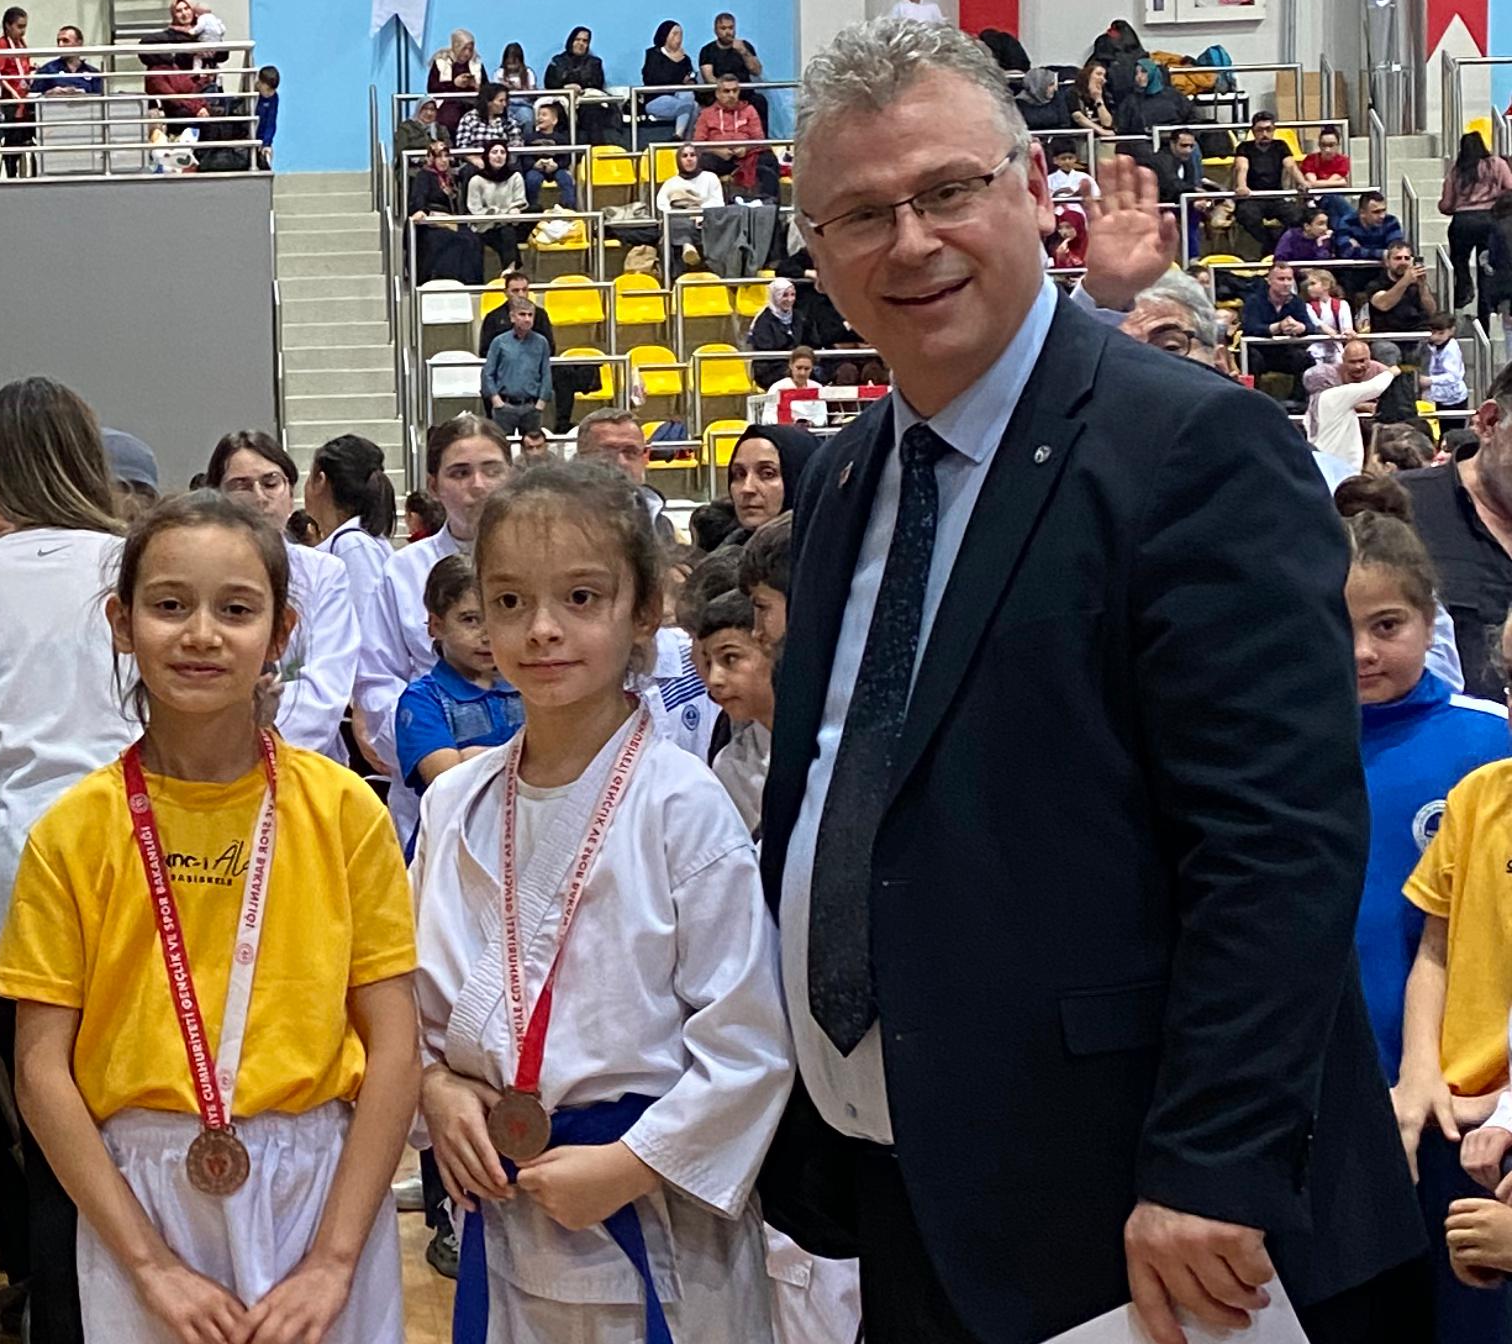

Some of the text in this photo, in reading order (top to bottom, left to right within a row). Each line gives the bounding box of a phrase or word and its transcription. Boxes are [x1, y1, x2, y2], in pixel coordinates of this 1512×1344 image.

[140, 824, 167, 894] BAKANLIĞI
[157, 895, 175, 931] SPOR
[166, 932, 179, 951] VE
[169, 950, 193, 1010] GENÇLİK
[184, 1012, 215, 1102] CUMHURİYETİ
